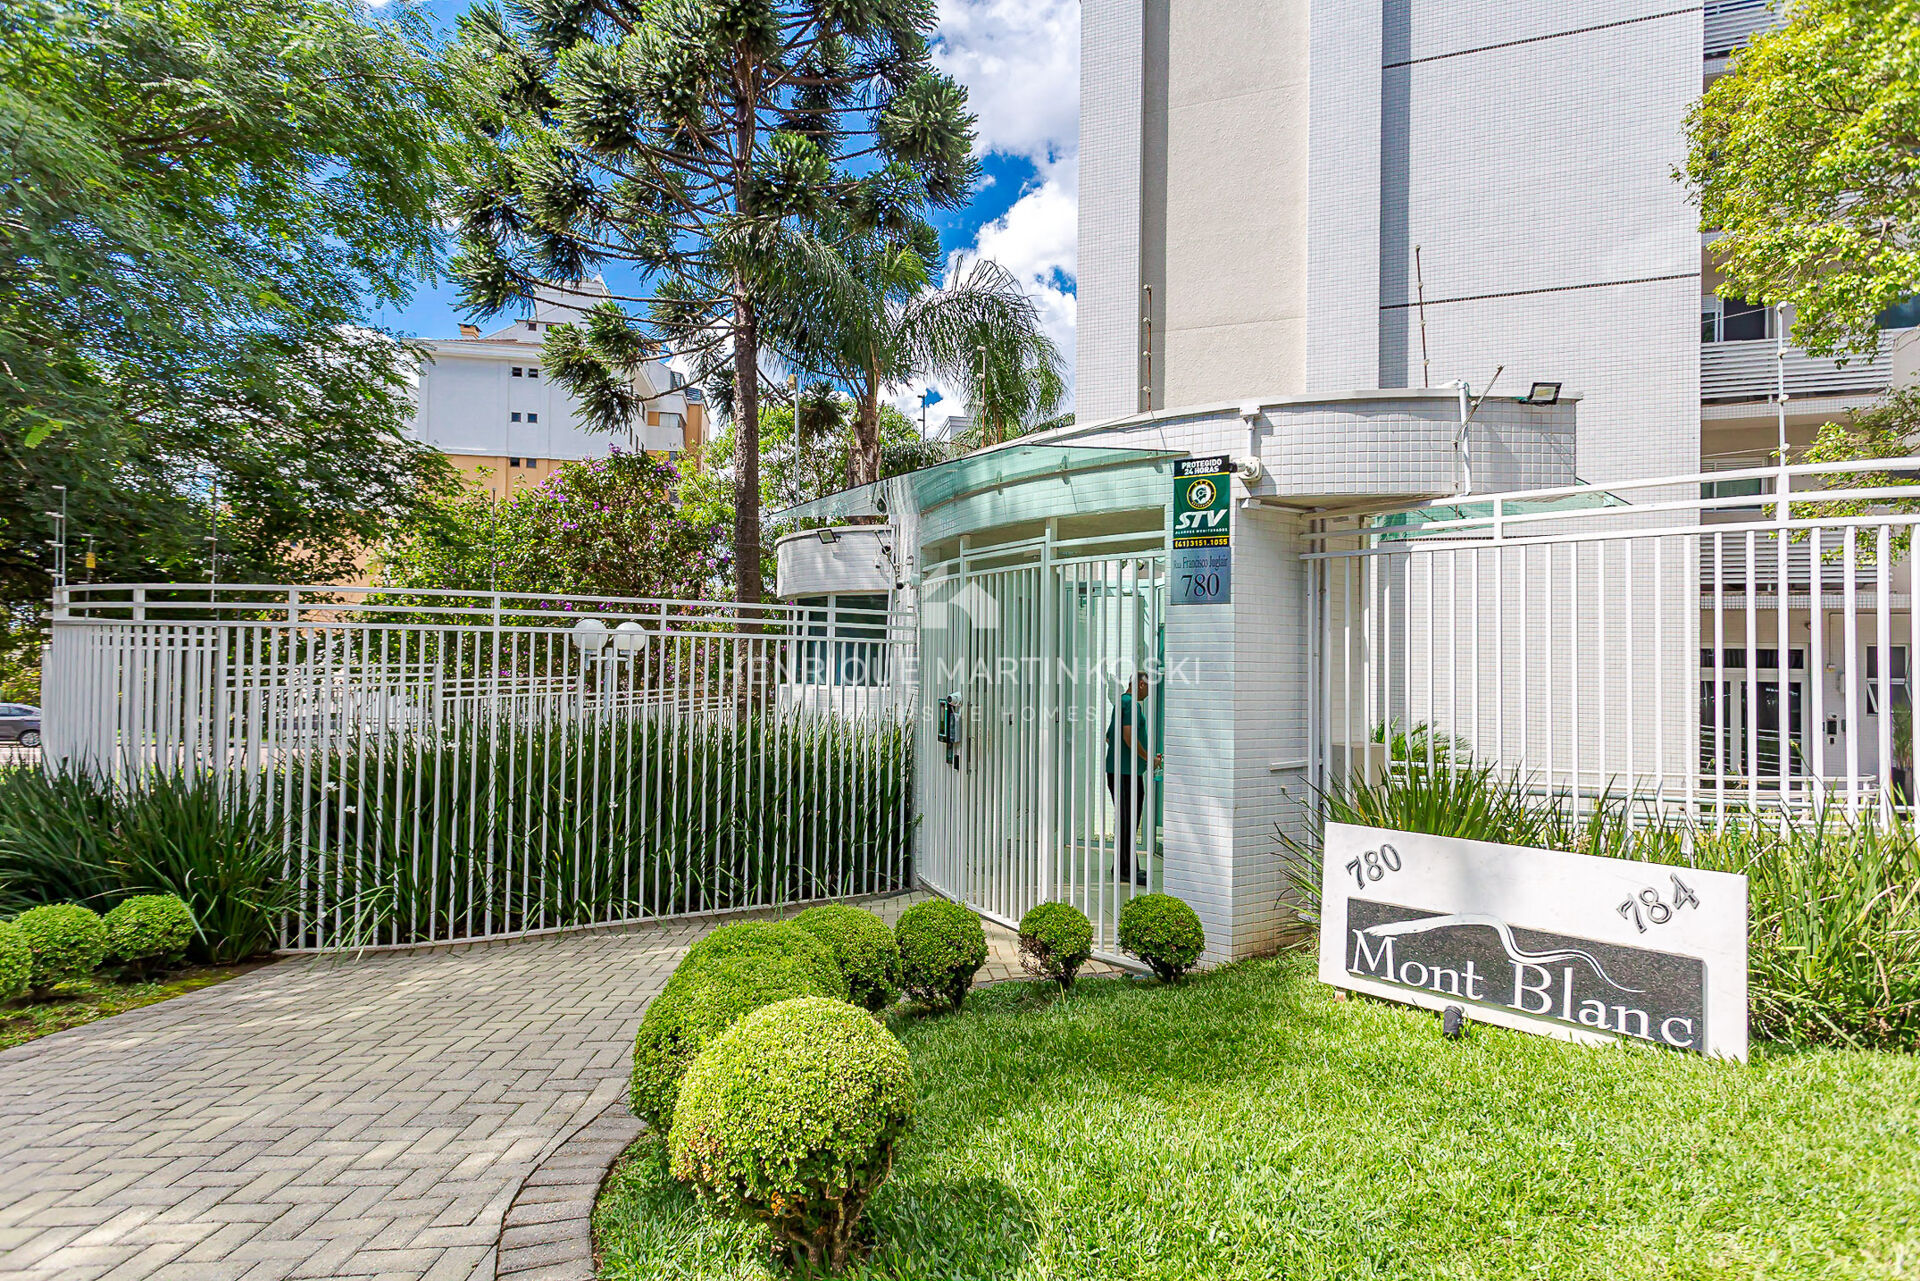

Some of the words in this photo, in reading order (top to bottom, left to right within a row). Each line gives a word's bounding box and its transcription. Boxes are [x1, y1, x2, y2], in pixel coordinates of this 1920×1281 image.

[1181, 458, 1222, 470] PROTEGIDO
[1194, 465, 1220, 474] HORAS
[1174, 509, 1228, 529] STV
[1182, 556, 1208, 569] Francisco
[1181, 573, 1219, 597] 780
[1345, 843, 1402, 890] 780
[1616, 872, 1701, 934] 784
[1348, 928, 1485, 1001] Mont
[1507, 959, 1695, 1049] Blanc
